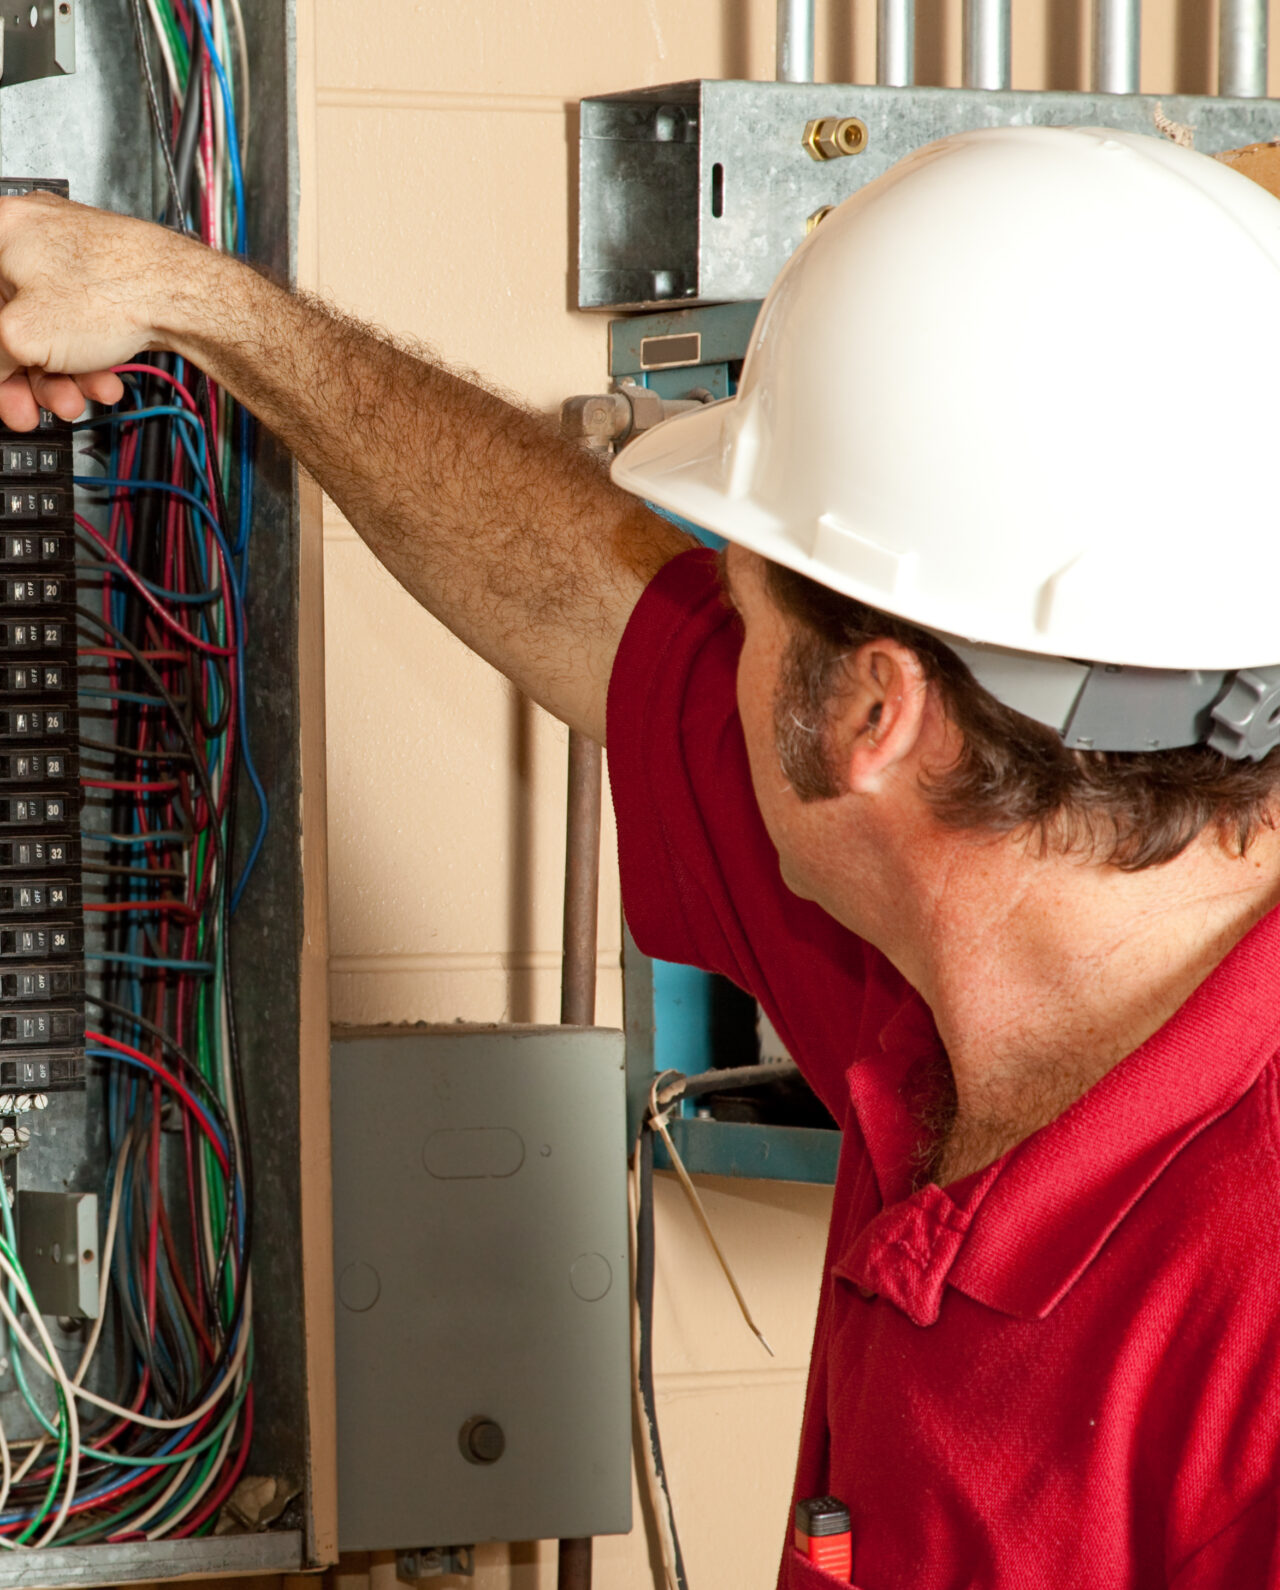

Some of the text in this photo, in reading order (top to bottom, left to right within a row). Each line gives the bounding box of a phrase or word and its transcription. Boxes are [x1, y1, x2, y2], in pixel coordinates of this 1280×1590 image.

[42, 411, 53, 423] 12
[42, 454, 53, 465] 14
[43, 499, 54, 510] 16
[44, 542, 55, 553] 18
[46, 585, 57, 596] 20
[46, 630, 57, 641] 22
[46, 673, 57, 684] 24
[47, 716, 59, 728] 26
[48, 761, 59, 773] 28
[48, 804, 59, 816] 30
[51, 848, 62, 860] 32
[52, 890, 63, 902] 34
[54, 934, 65, 946] 36
